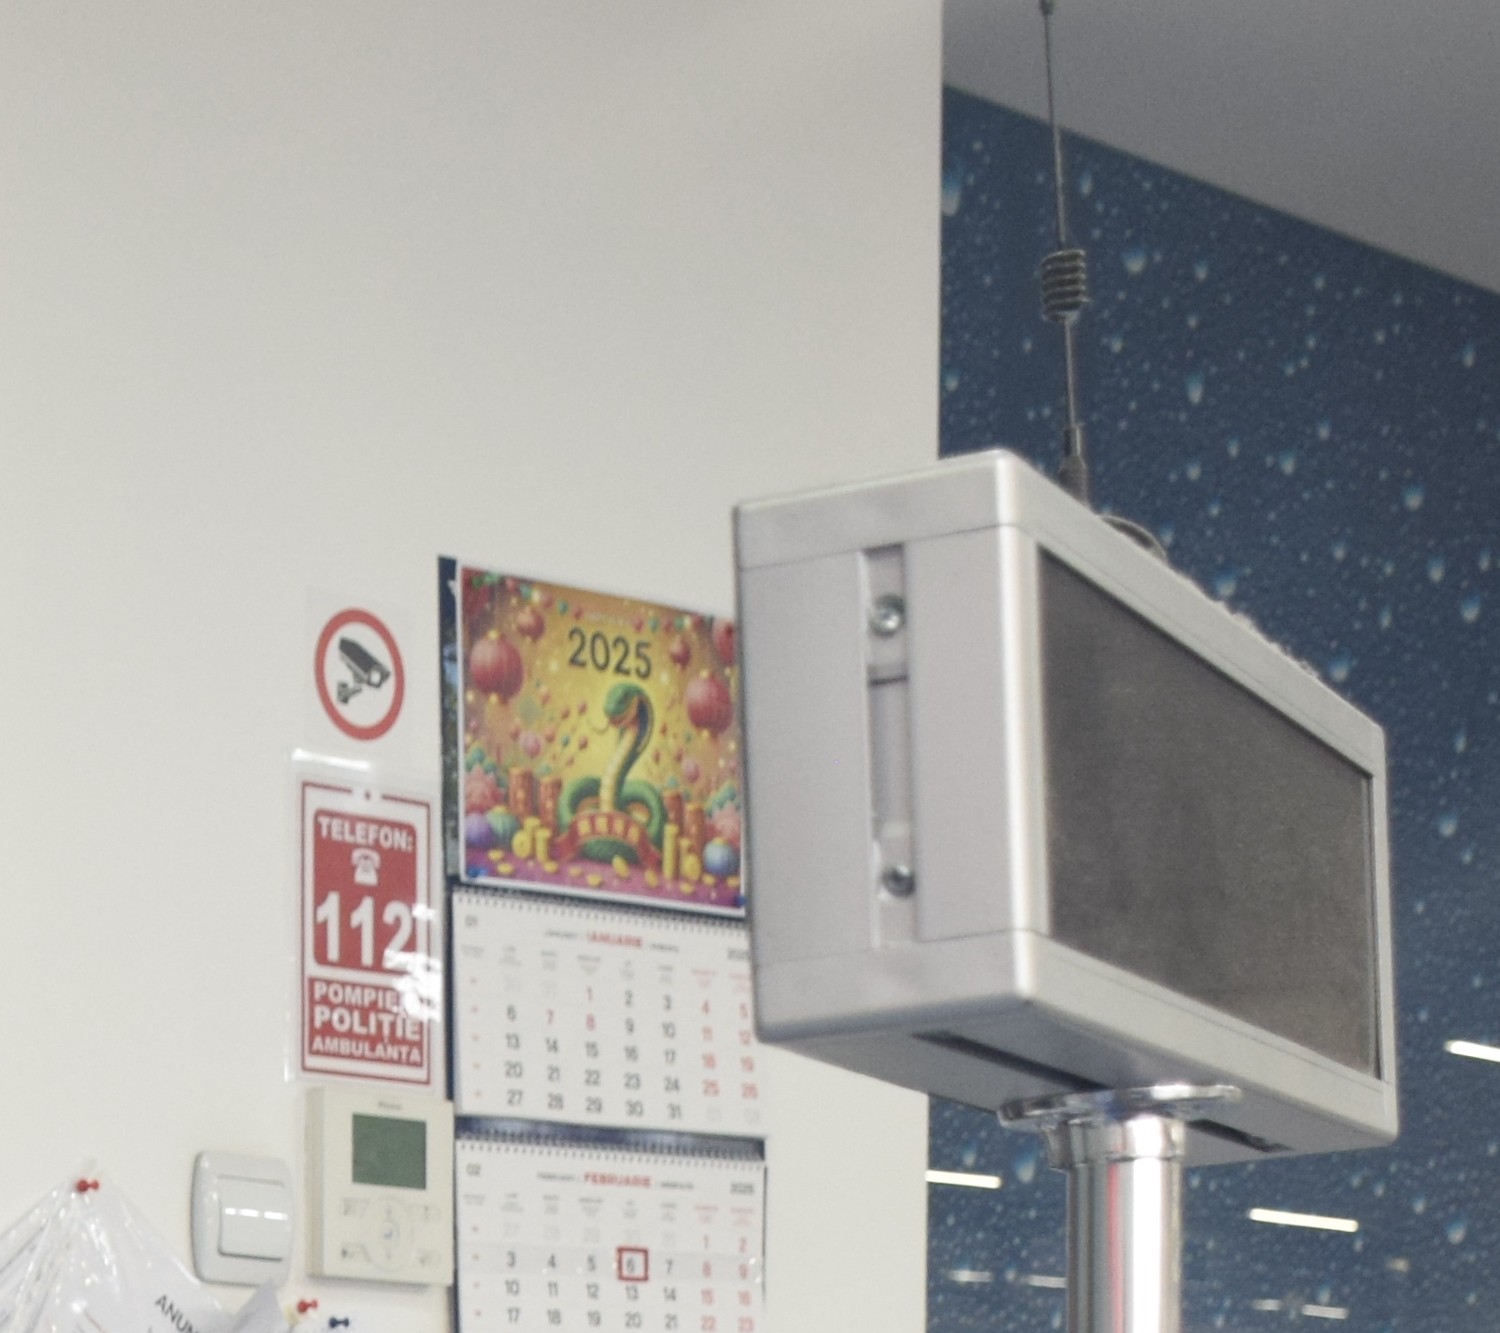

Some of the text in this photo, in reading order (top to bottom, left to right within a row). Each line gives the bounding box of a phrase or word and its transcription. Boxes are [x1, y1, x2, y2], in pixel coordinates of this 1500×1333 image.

[568, 626, 652, 679] 2025
[317, 815, 414, 850] TELEFON:
[315, 890, 417, 971] 112
[313, 981, 422, 1020] POMPIE
